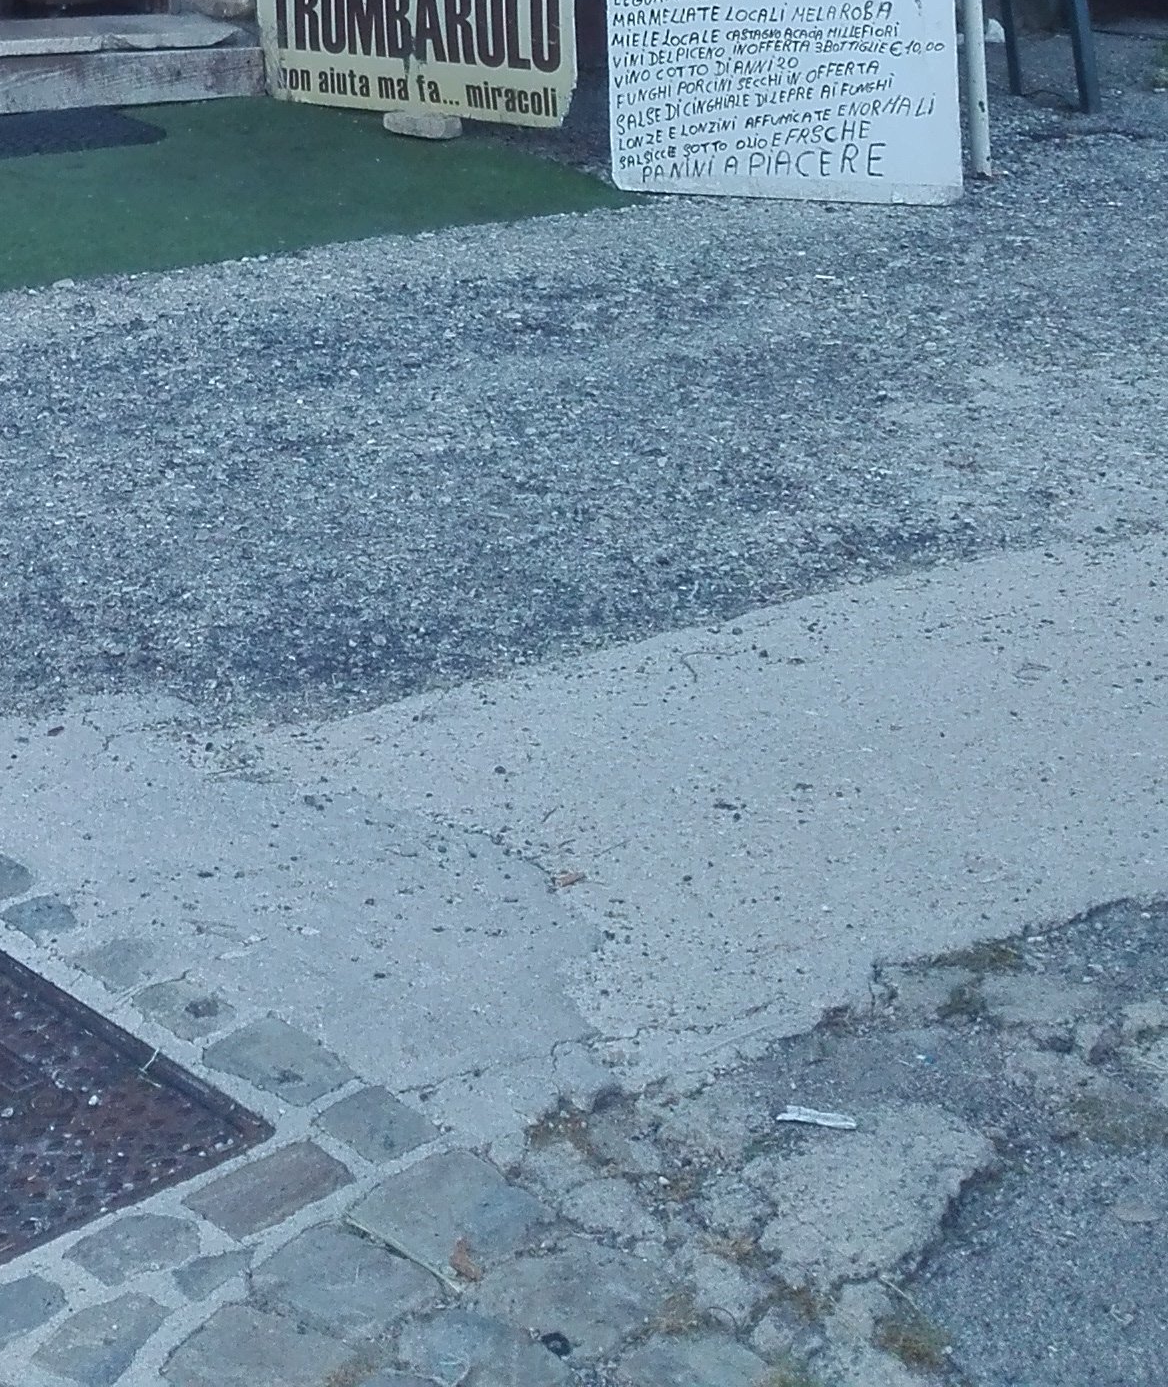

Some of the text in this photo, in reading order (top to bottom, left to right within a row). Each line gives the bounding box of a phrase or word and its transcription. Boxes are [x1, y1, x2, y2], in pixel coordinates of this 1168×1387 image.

[318, 66, 371, 98] aiuta
[378, 74, 409, 102] ma
[465, 81, 559, 118] miracoli
[641, 143, 887, 183] PANINI A PIACERE
